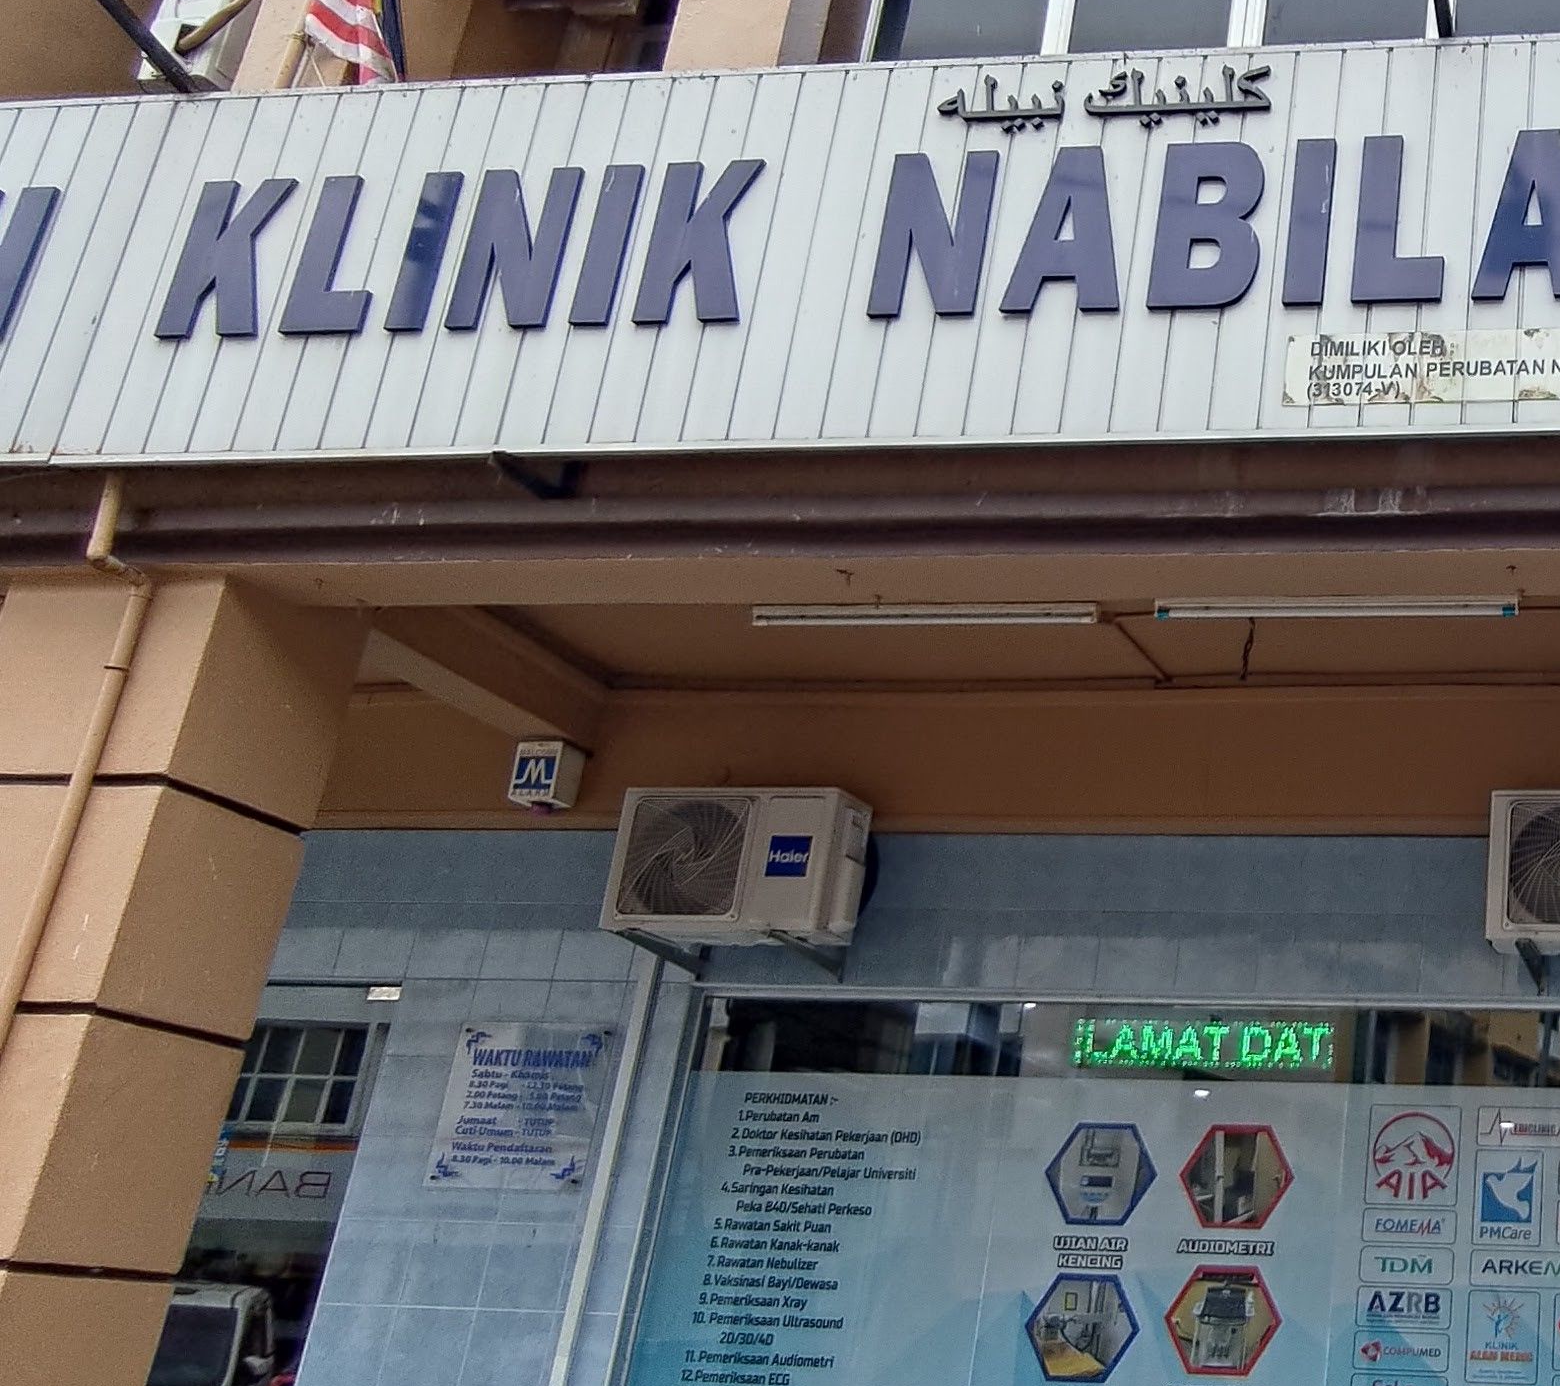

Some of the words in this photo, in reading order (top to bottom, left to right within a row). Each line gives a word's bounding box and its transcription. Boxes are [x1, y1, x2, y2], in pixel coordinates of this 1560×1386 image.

[153, 158, 767, 340] KLINIK
[1310, 339, 1388, 358] DIMILIKI
[1391, 338, 1445, 358] OLEH
[1308, 362, 1418, 381] KUMPULAN
[1425, 359, 1546, 378] PERUBATAN
[768, 850, 809, 863] Haier
[473, 1048, 521, 1067] WAKTU
[744, 1092, 828, 1106] PERKHIDMATAN
[802, 1111, 819, 1123] Am
[780, 1129, 832, 1142] Kesihatan
[835, 1130, 888, 1145] Pekerjaan
[809, 1147, 865, 1161] Perubatan
[863, 1167, 917, 1181] Universiti
[781, 1183, 834, 1197] Kesihatan
[1375, 1169, 1449, 1200] AIA
[736, 1200, 762, 1214] Peka
[827, 1203, 872, 1216] Perkeso
[773, 1220, 800, 1233] Sakit
[803, 1221, 832, 1233] Puan
[1375, 1218, 1442, 1235] FOMEMA
[1479, 1226, 1532, 1240] PMCare
[770, 1238, 840, 1253] Kanak-kanak
[1053, 1235, 1096, 1252] UJIAN
[1099, 1237, 1128, 1253] AIR
[1177, 1240, 1274, 1256] AUDIOMETRI
[766, 1257, 819, 1271] Nebulizer
[1058, 1254, 1122, 1269] KENCING
[1374, 1256, 1433, 1274] TDM
[768, 1275, 839, 1290] Bayi/Dewasa
[782, 1295, 808, 1310] Xray
[1367, 1291, 1441, 1314] AZRB
[708, 1312, 780, 1327] Pemeriksaan
[782, 1315, 844, 1330] Ultrasound
[698, 1351, 770, 1366] Pemeriksaan
[772, 1354, 835, 1368] Audiometri
[1383, 1346, 1441, 1358] COMPUMED
[768, 1373, 790, 1386] ECG
